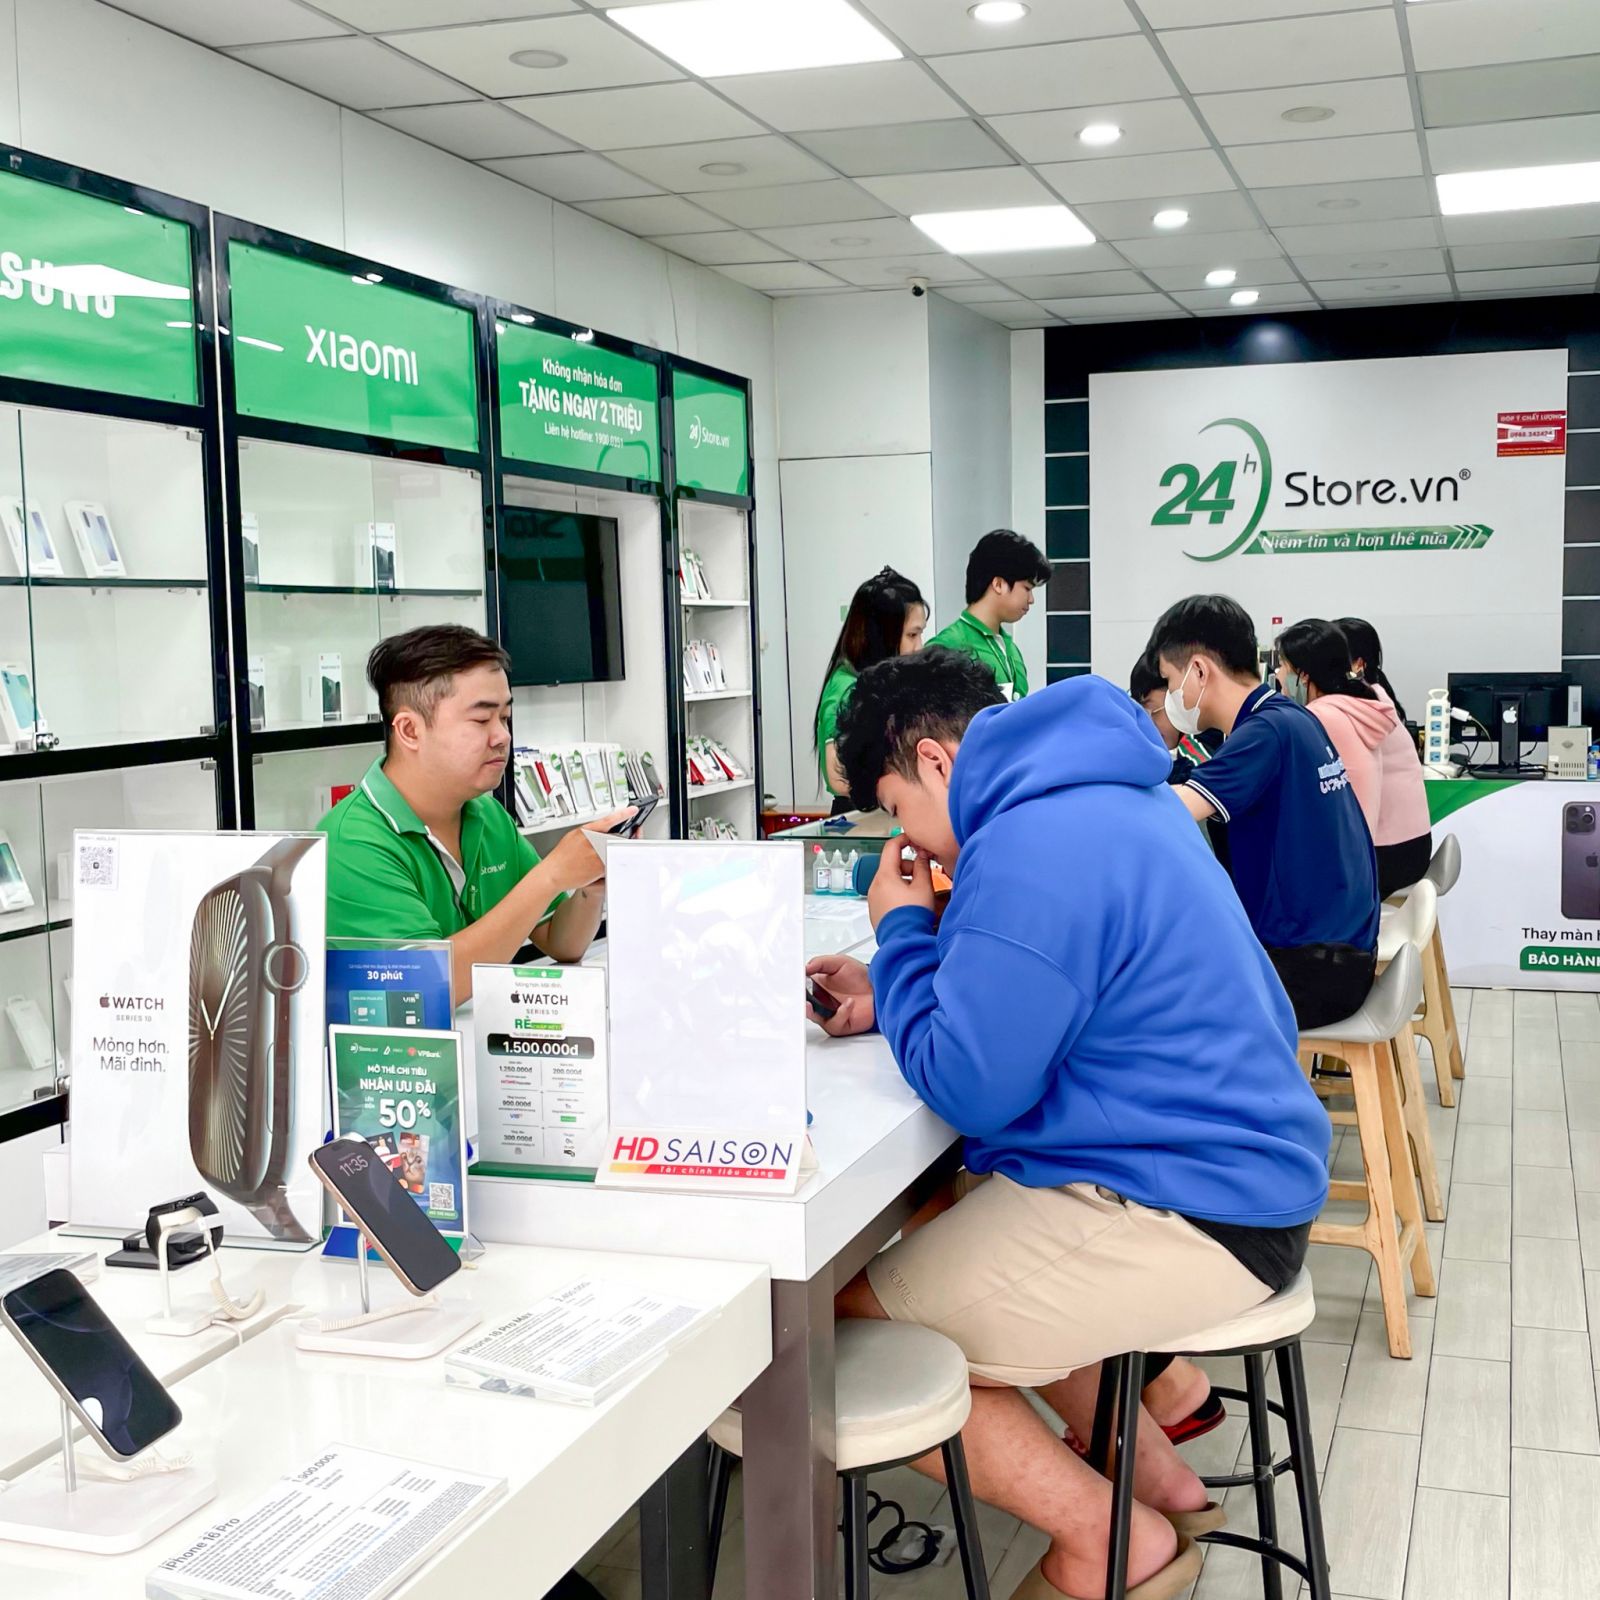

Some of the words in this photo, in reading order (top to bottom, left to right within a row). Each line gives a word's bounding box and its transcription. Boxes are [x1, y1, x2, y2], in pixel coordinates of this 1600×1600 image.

[542, 358, 571, 382] Không
[573, 366, 592, 386] nhận
[594, 370, 607, 388] hóa
[609, 376, 622, 392] đơn
[519, 378, 560, 414] TẶNG
[562, 391, 598, 421] NGAY
[600, 401, 608, 423] 2
[609, 402, 642, 434] TRIỆU
[545, 422, 559, 435] Liên
[561, 425, 569, 439] hệ
[1308, 535, 1327, 548] tin
[1334, 533, 1350, 547] và
[1356, 533, 1384, 547] hơn
[1390, 529, 1414, 546] thế
[1420, 532, 1447, 545] nữa
[1522, 927, 1557, 942] Thay
[1561, 928, 1593, 941] màn
[1528, 951, 1559, 965] BẢO
[367, 970, 379, 980] 30
[381, 970, 403, 982] phút
[112, 996, 164, 1010] WATCH
[522, 993, 568, 1005] WATCH
[116, 1014, 142, 1022] SERIES
[144, 1014, 152, 1022] 10
[100, 1056, 126, 1071] Mãi
[397, 1067, 409, 1075] CHI
[360, 1076, 393, 1094] NHẬN
[396, 1080, 412, 1093] ƯU
[415, 1079, 436, 1094] ĐÃI
[379, 1098, 431, 1129] 50%
[612, 1137, 659, 1161] HD
[664, 1138, 792, 1166] SAISON
[340, 1155, 369, 1177] 11:35
[660, 1165, 676, 1174] Tài
[681, 1166, 712, 1175] chính
[717, 1167, 740, 1176] tiêu
[745, 1168, 774, 1178] dùng
[160, 1541, 208, 1571] iPhone
[203, 1531, 221, 1541] 16
[215, 1518, 240, 1533] Pro
